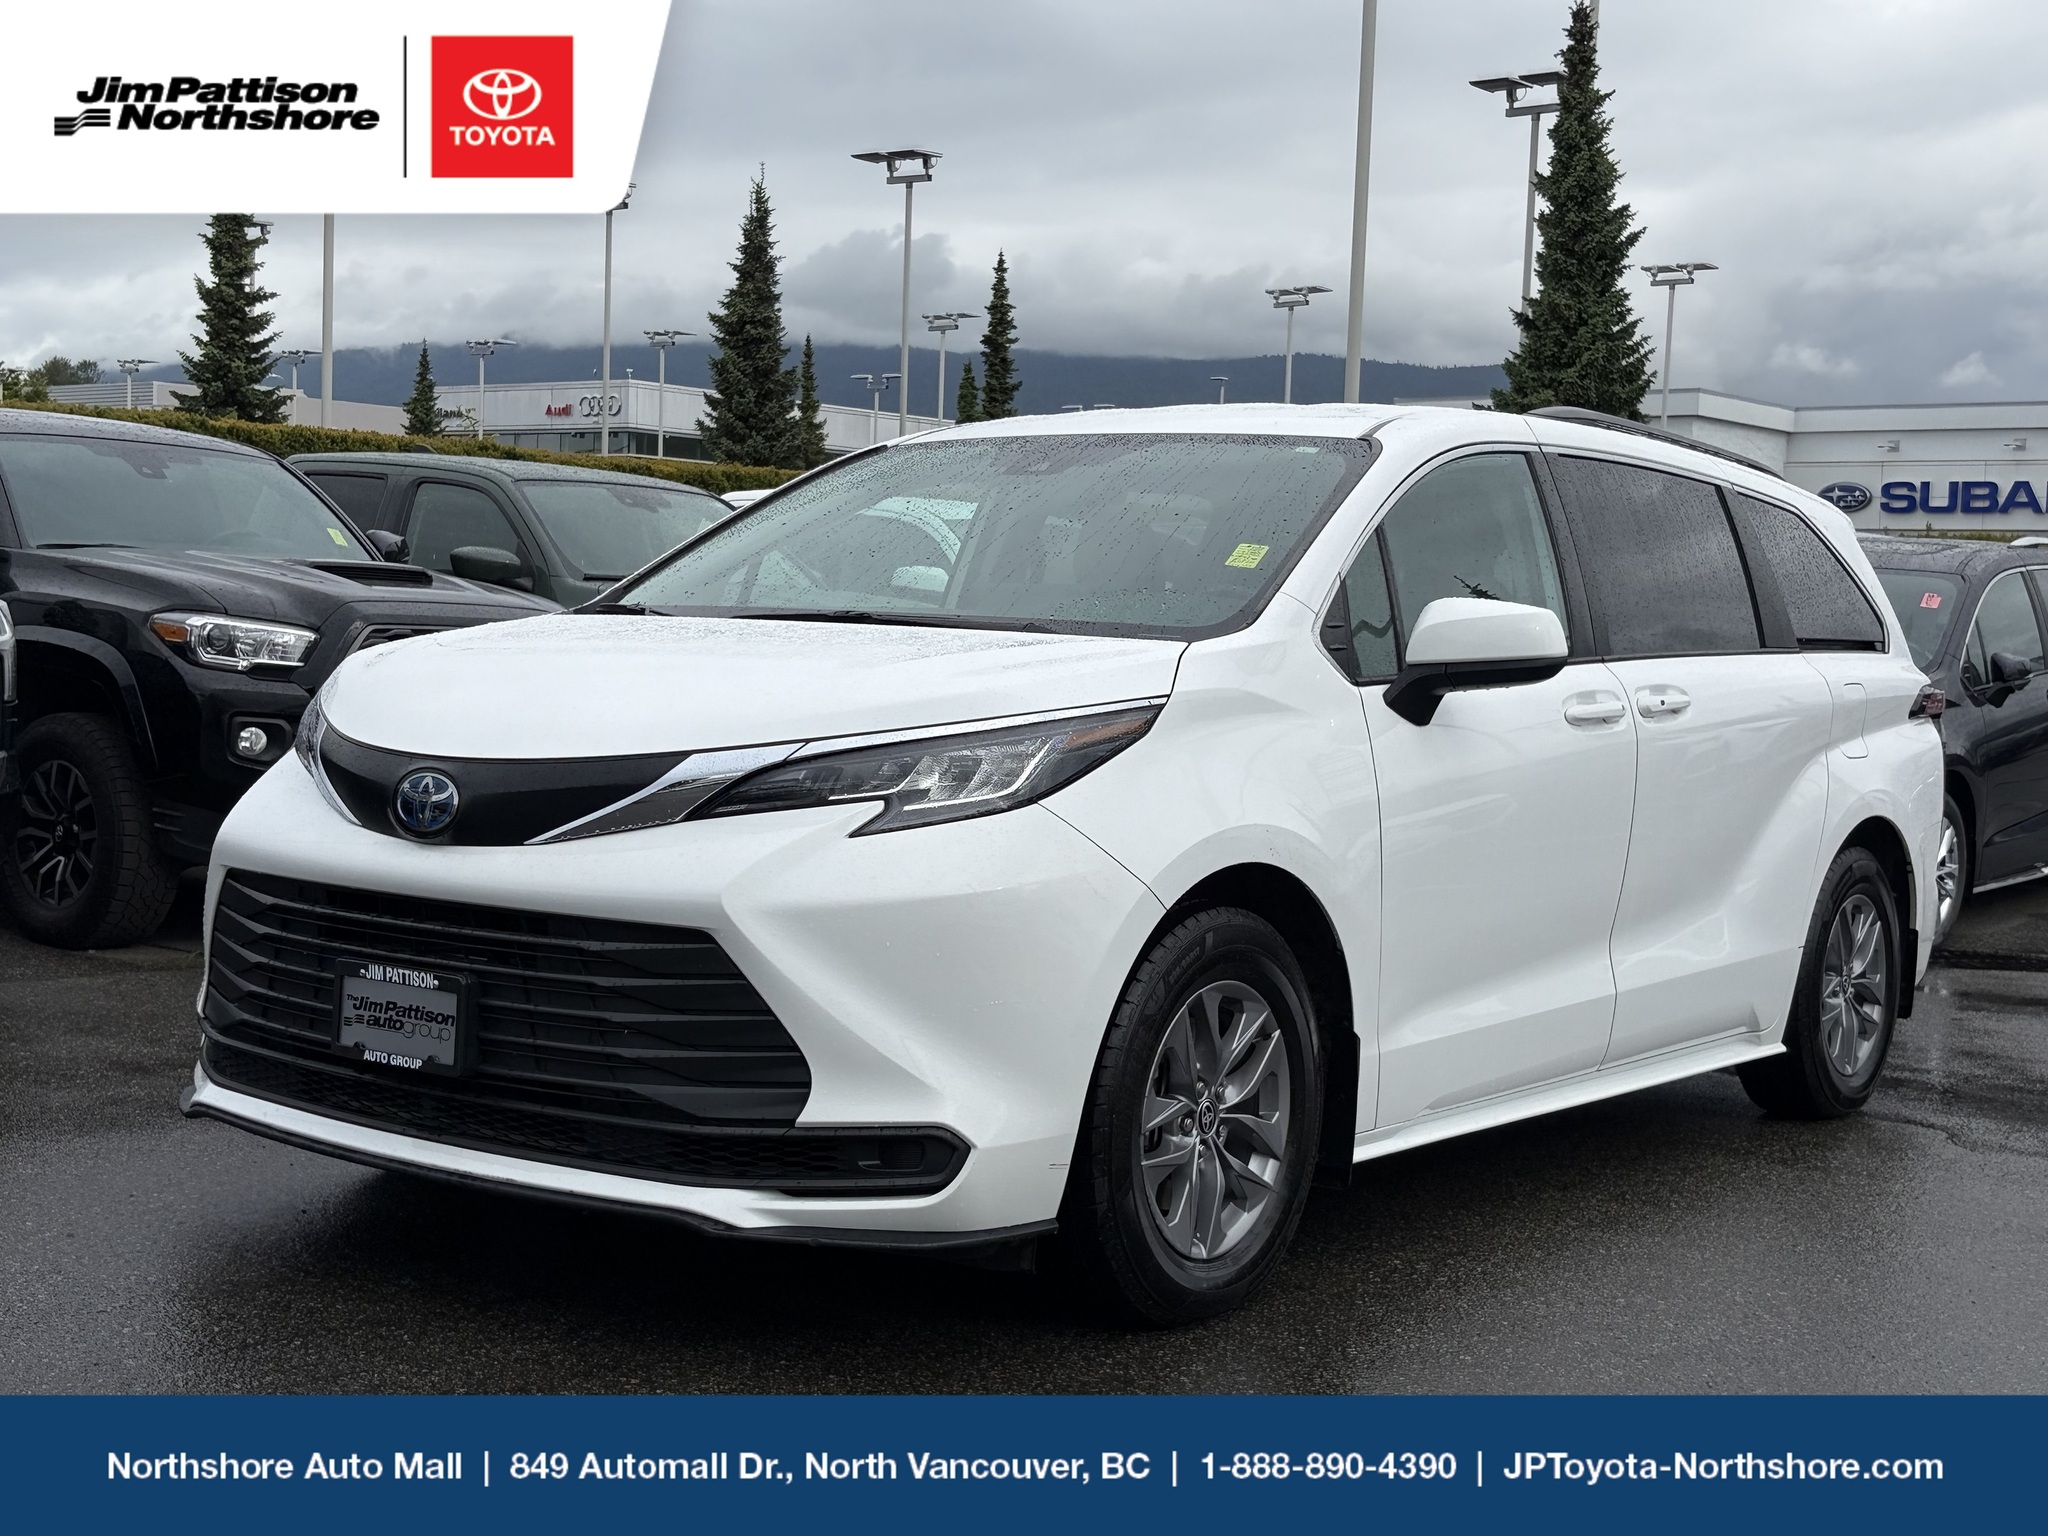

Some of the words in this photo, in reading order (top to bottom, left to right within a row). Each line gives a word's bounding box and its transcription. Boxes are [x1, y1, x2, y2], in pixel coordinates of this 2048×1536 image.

[545, 403, 573, 417] Audi
[1880, 481, 2048, 514] SUBA
[365, 964, 384, 981] JIM
[386, 966, 434, 989] PATTISON
[346, 994, 360, 1002] The
[363, 1049, 388, 1064] AUTO
[389, 1054, 423, 1070] GROUP
